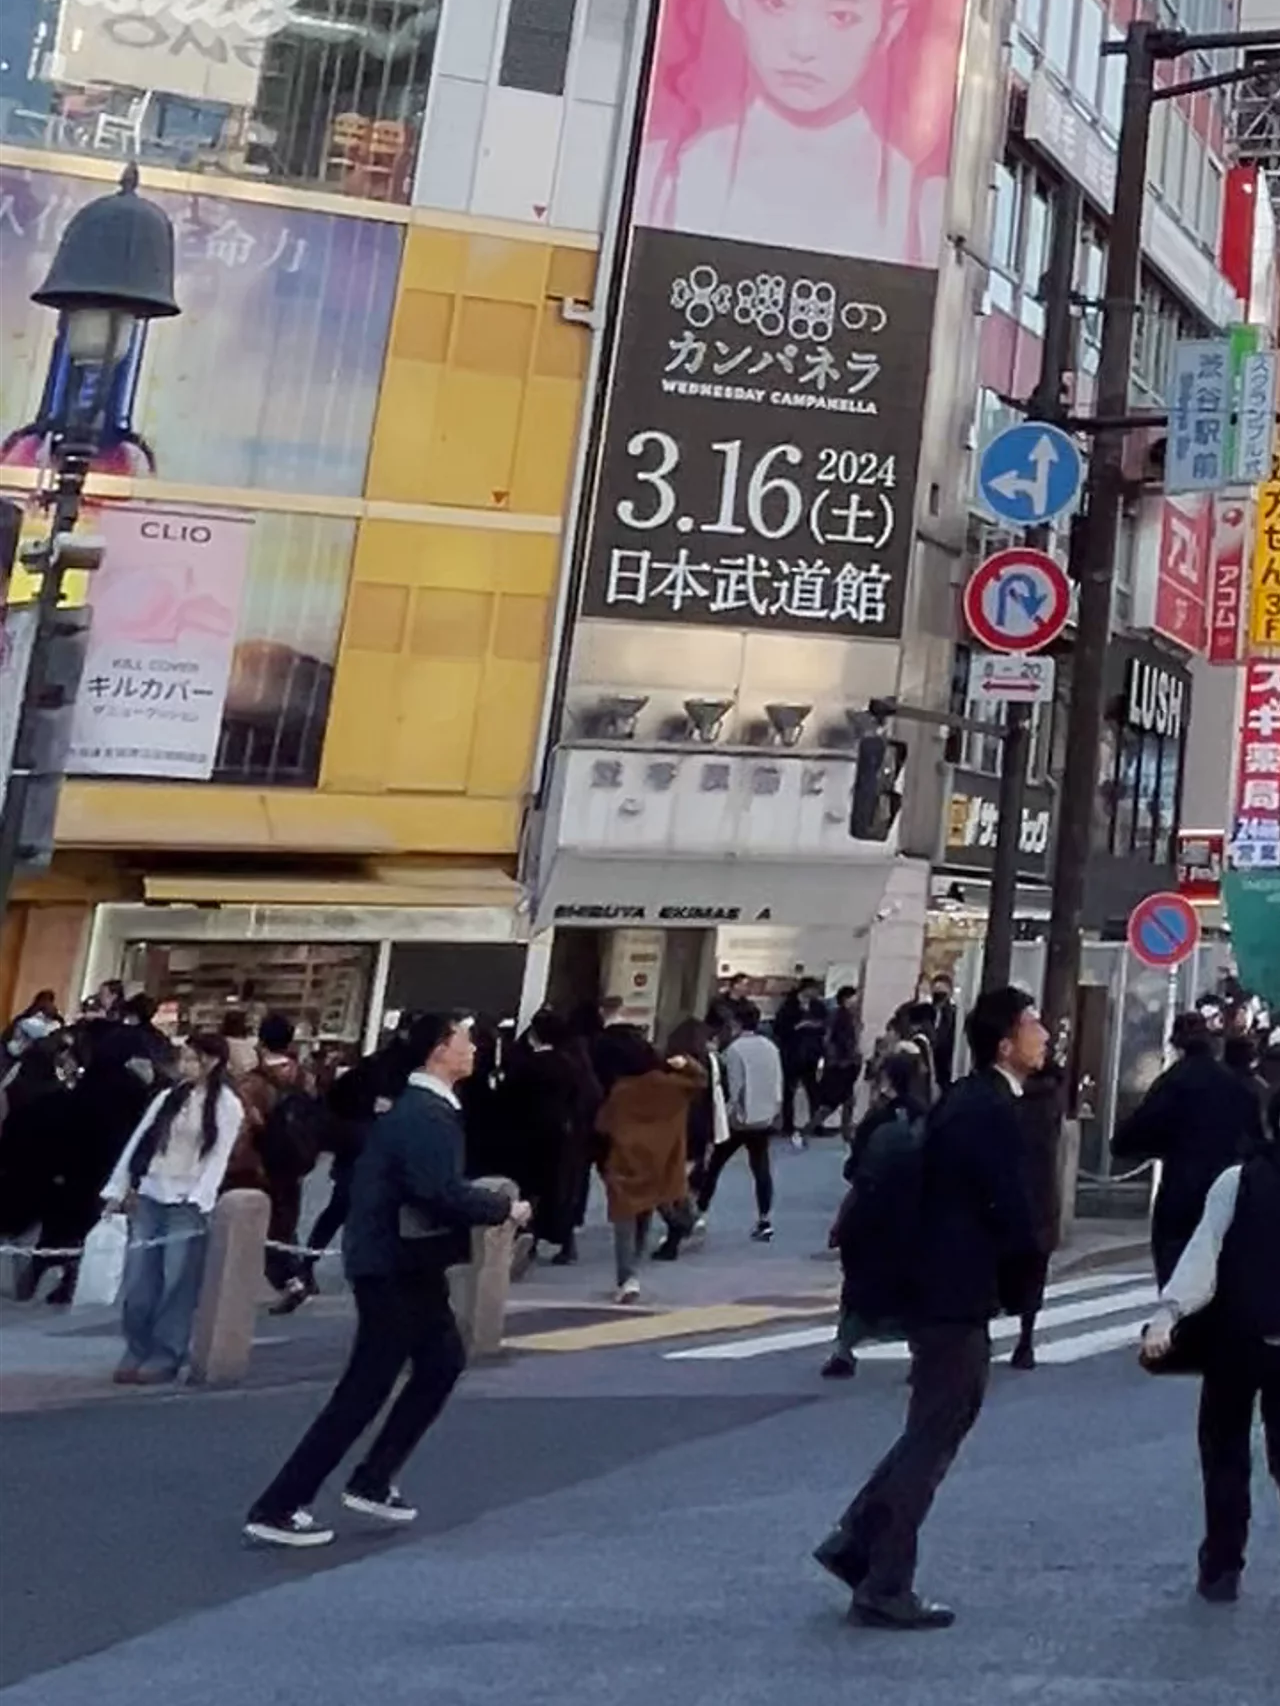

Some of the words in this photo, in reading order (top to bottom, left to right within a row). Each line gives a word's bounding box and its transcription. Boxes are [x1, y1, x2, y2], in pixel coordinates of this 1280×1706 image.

[664, 330, 882, 394] カンパネラ
[661, 378, 766, 404] WEDNESDAY
[769, 389, 878, 415] CAMPANELLA
[616, 429, 803, 541] 3.16
[816, 448, 897, 489] 2024
[140, 521, 212, 545] CLIO
[808, 489, 895, 549] (土)
[606, 546, 892, 625] 日本武道館
[1214, 563, 1240, 628] アコム
[88, 676, 214, 701] キルカバー
[1128, 657, 1184, 739] LUSH
